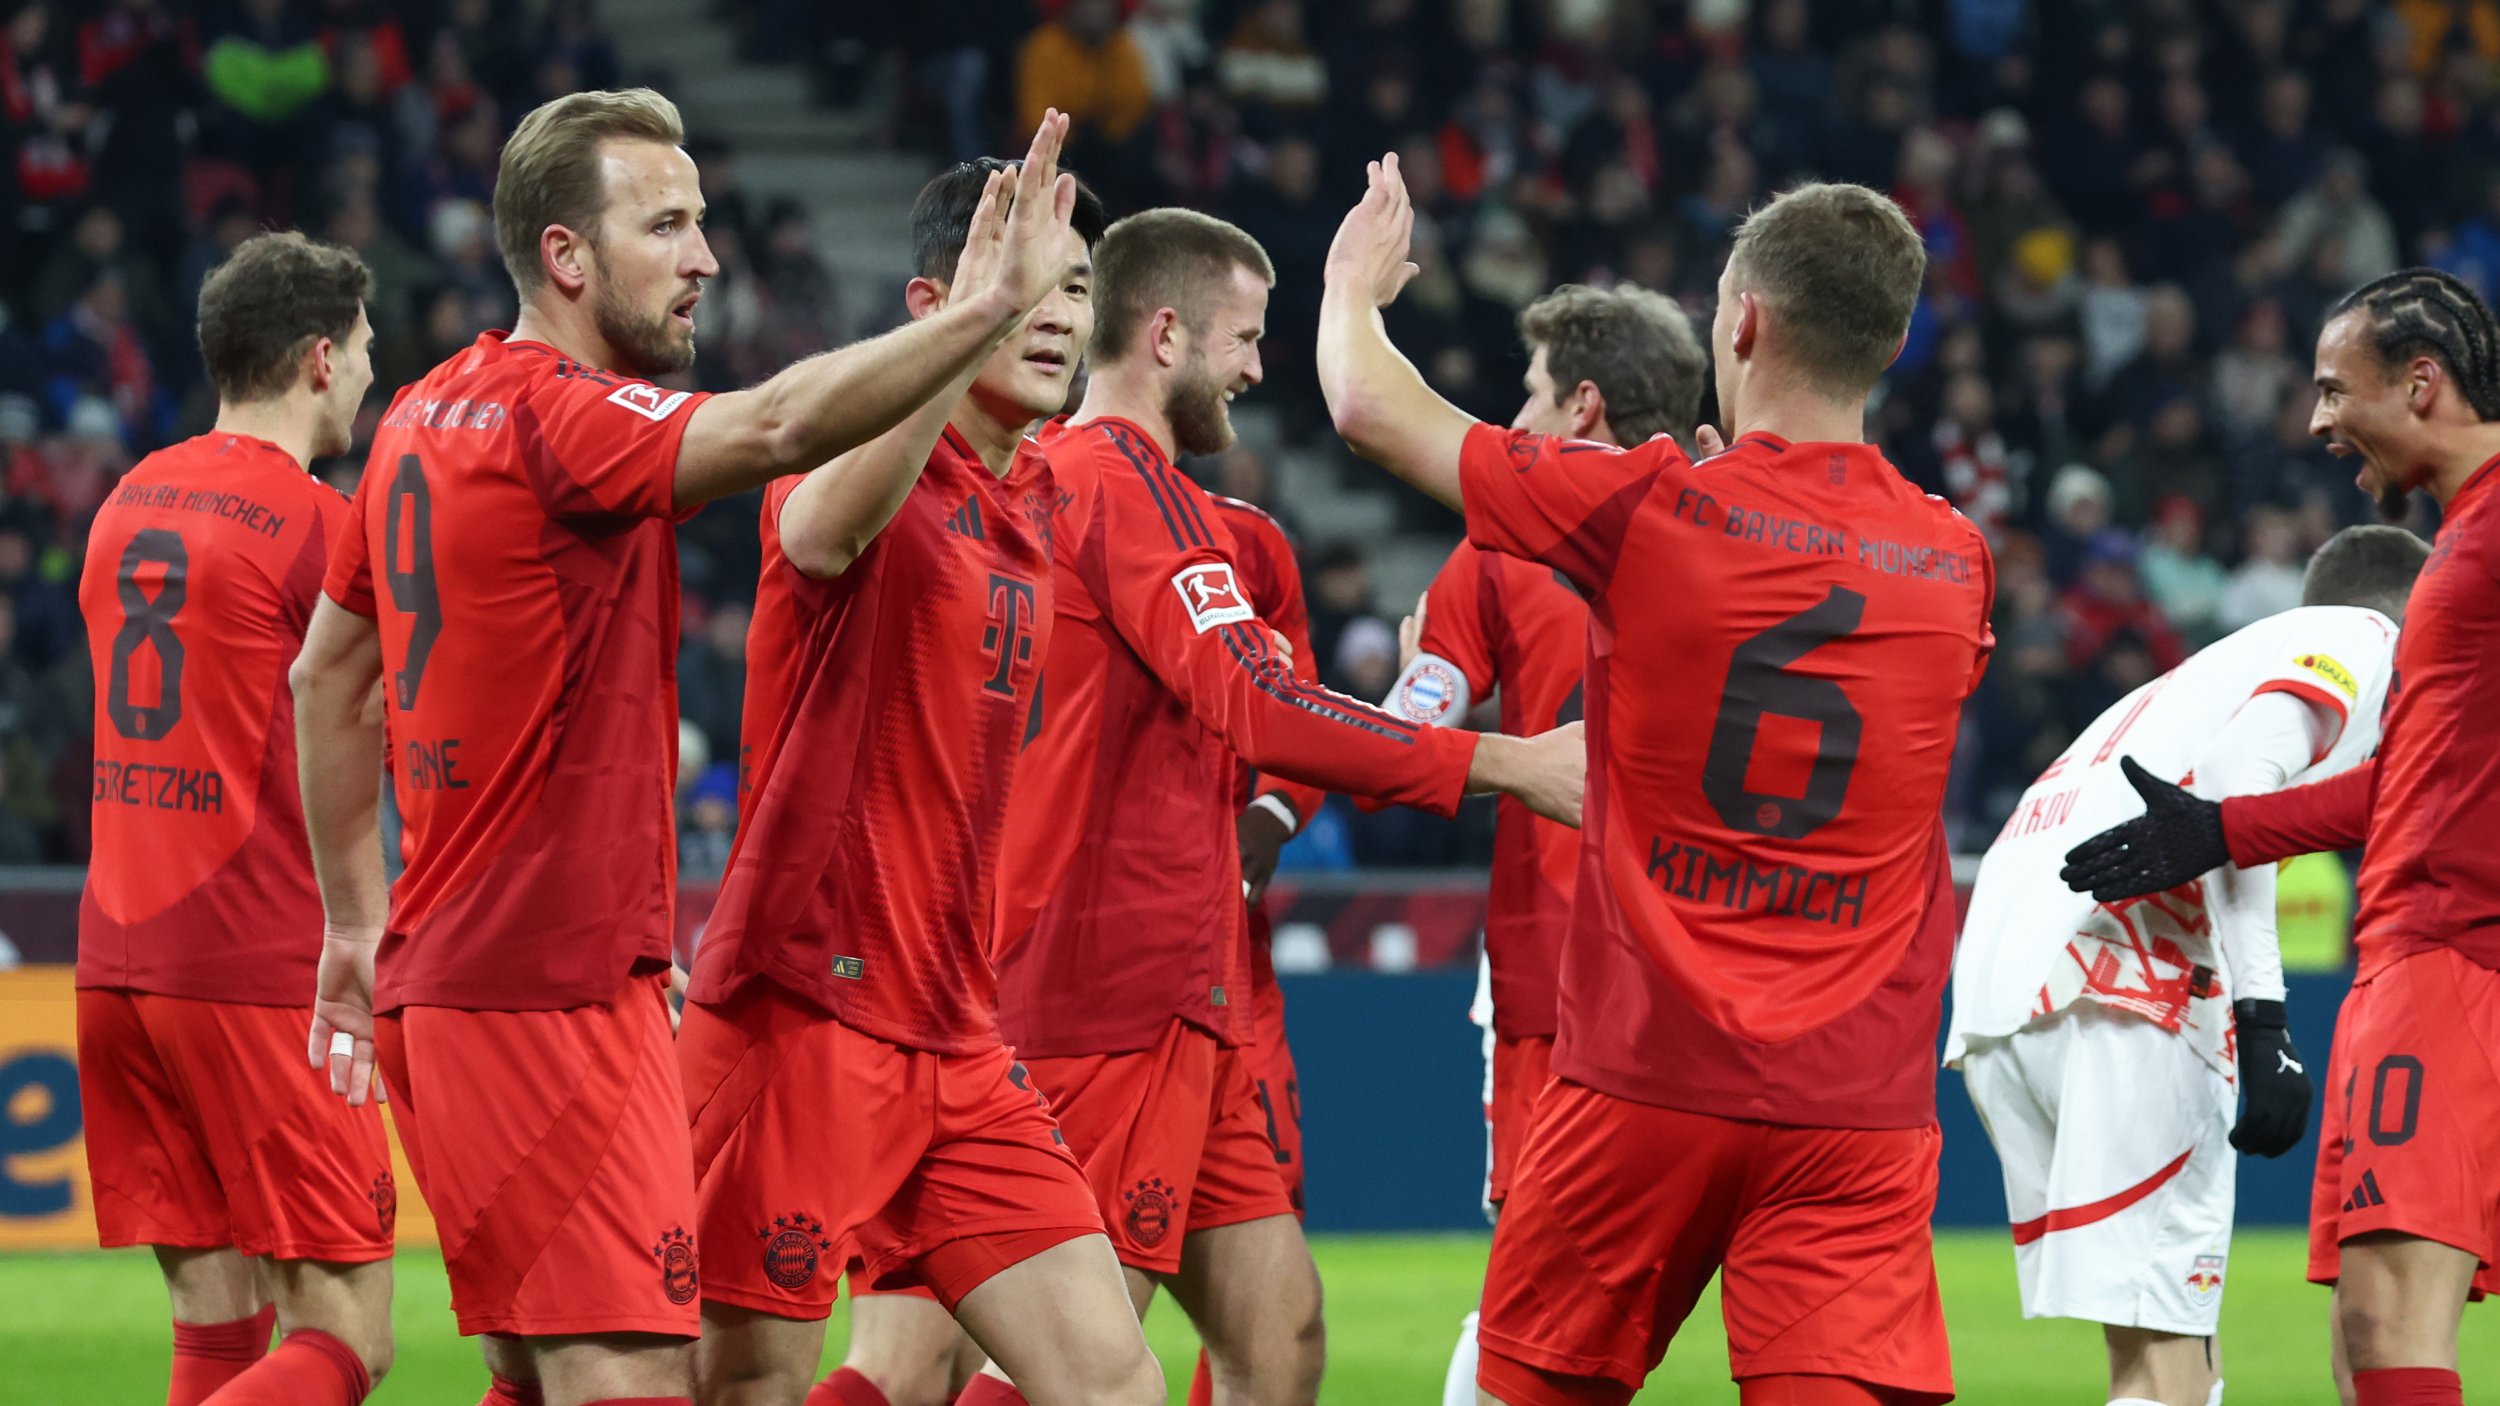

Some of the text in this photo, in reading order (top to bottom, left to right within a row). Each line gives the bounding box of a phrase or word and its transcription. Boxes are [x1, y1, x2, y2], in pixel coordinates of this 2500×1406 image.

[384, 453, 444, 712] 9
[1673, 487, 1970, 584] FC BAYERN MÜNCHEN
[107, 528, 189, 741] 8
[1701, 583, 1867, 841] 6
[406, 739, 470, 791] ANE
[1647, 835, 1868, 928] KIMMICH
[772, 1234, 815, 1259] FC BAYERN
